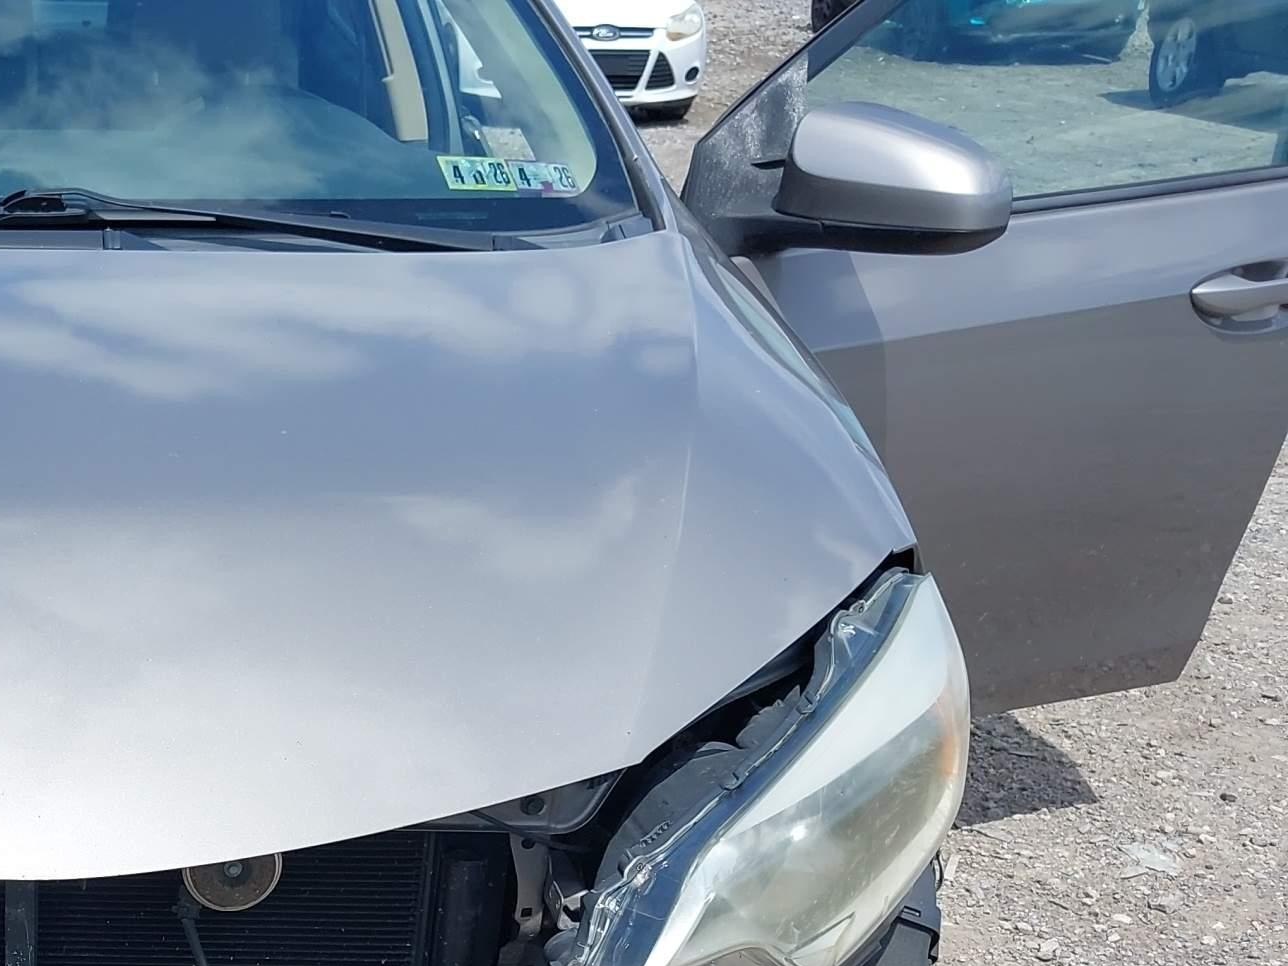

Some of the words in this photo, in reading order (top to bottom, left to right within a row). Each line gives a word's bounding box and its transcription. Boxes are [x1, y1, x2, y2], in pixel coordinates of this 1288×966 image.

[453, 165, 466, 185] 4
[487, 162, 511, 185] 26
[518, 167, 532, 187] 4
[553, 166, 576, 188] 26
